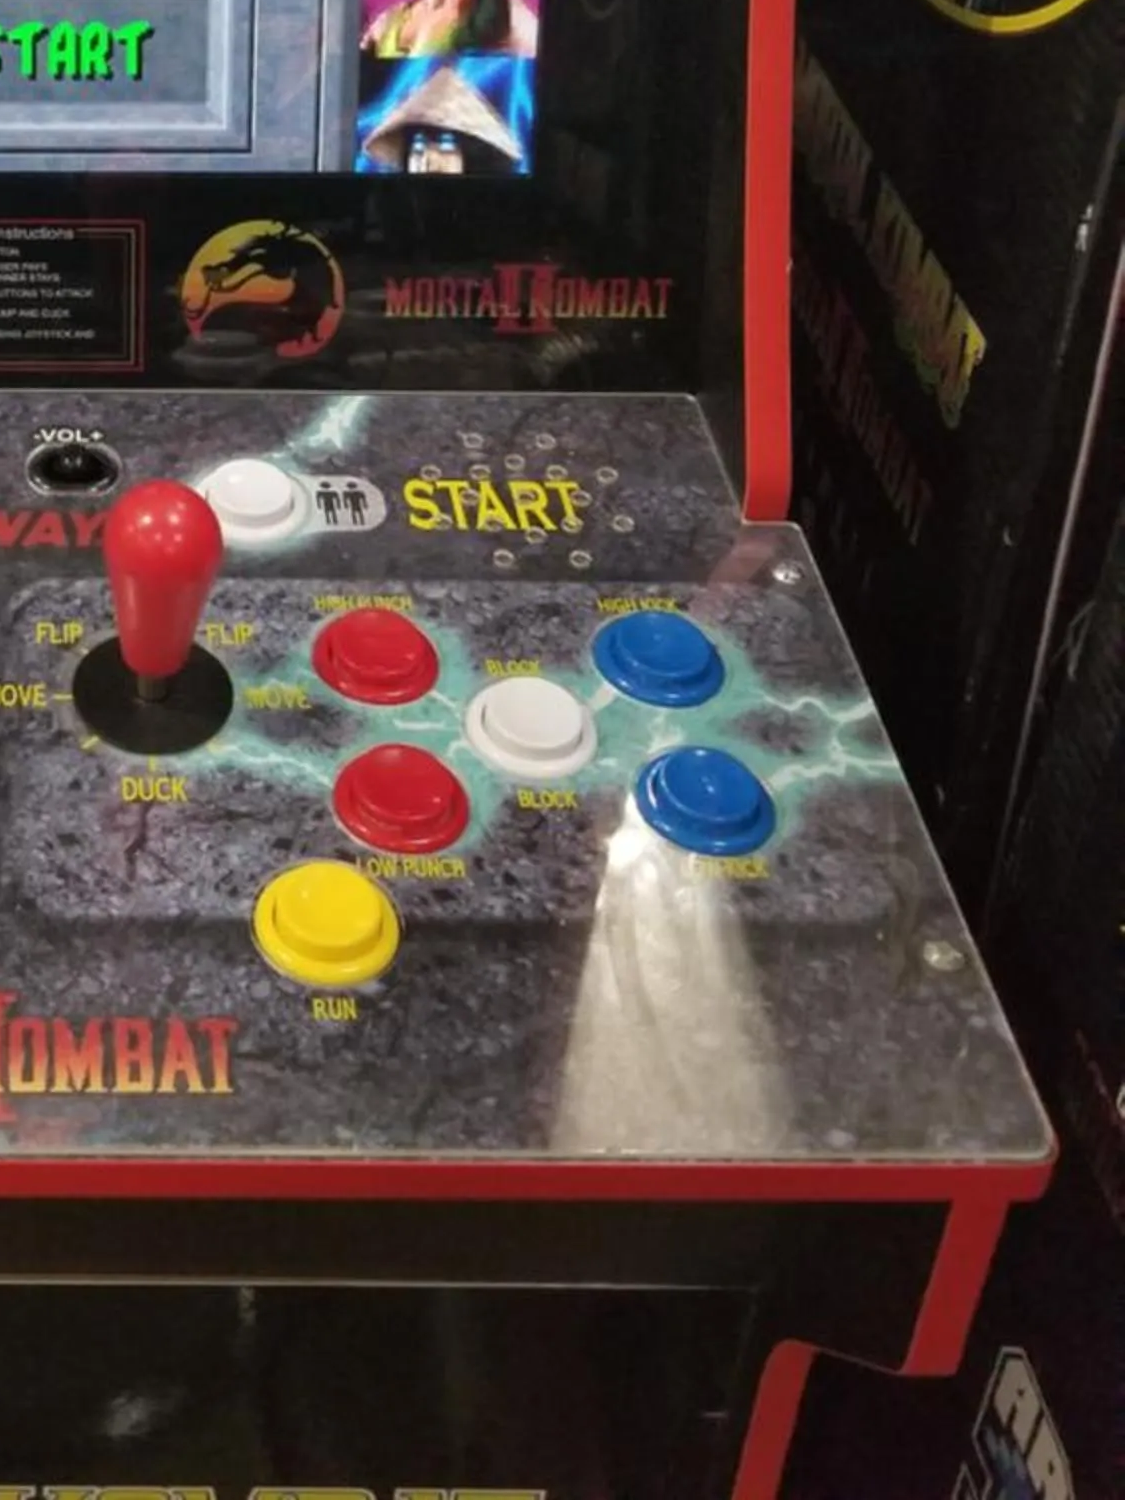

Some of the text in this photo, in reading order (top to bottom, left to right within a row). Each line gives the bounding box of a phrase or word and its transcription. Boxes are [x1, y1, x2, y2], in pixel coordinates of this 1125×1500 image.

[383, 277, 522, 319] MORTAL
[528, 277, 673, 319] KOMBAT
[402, 479, 581, 532] START
[35, 622, 84, 644] FLIP
[206, 623, 254, 645] FLIP
[122, 777, 187, 802] DUCK
[517, 788, 578, 809] BLOCK
[312, 997, 358, 1021] RUN
